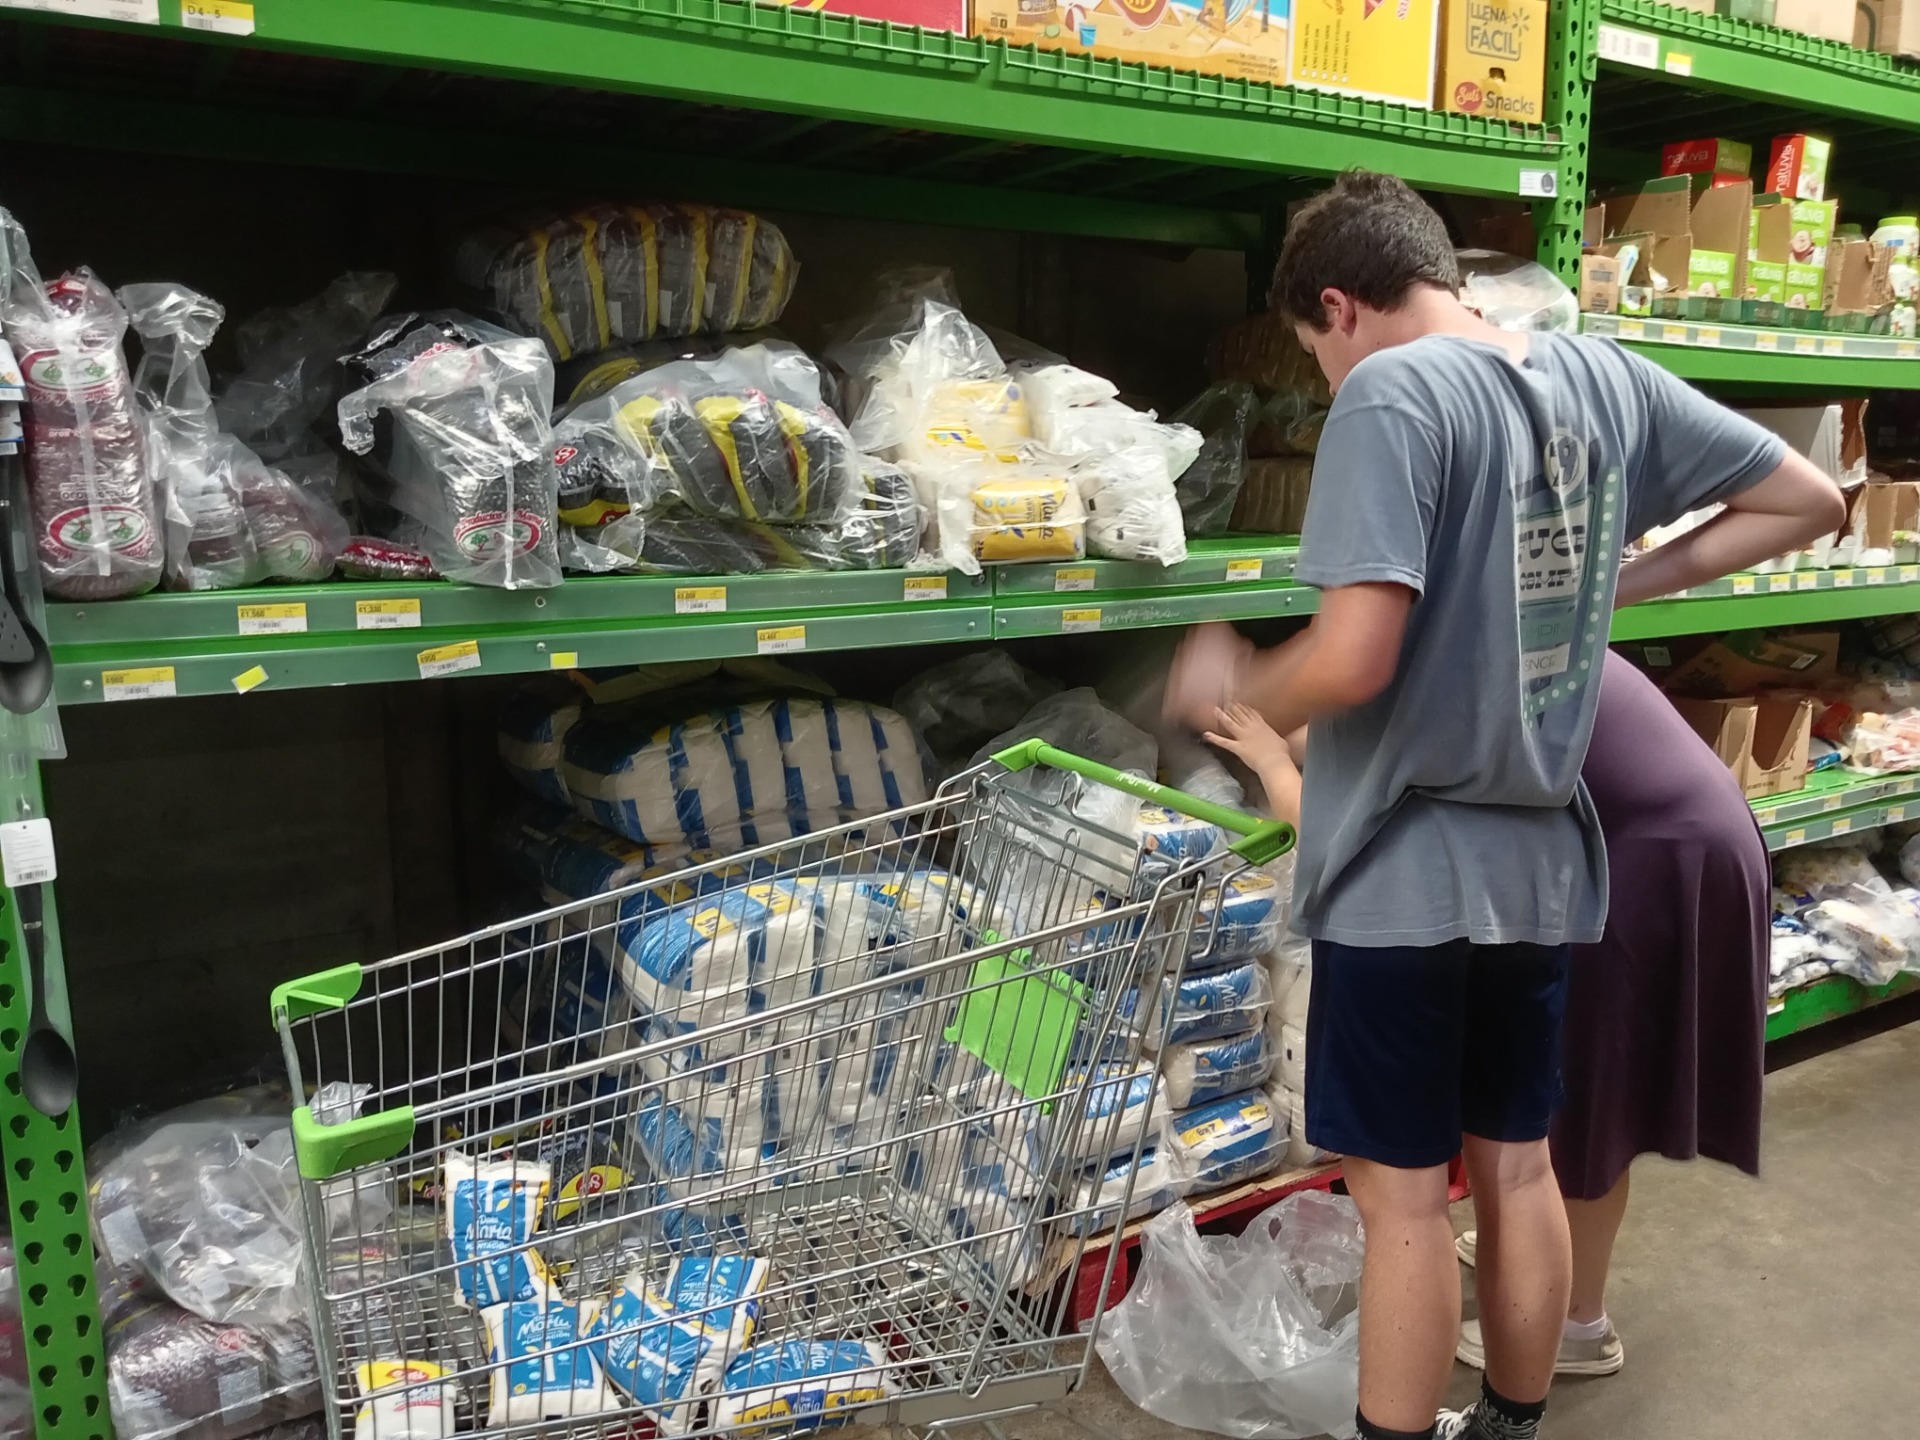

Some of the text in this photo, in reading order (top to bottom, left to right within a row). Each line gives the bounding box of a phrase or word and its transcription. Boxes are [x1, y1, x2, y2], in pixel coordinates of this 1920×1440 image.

[1470, 21, 1517, 55] FÁCIL
[1485, 91, 1535, 115] Snacks
[1667, 149, 1709, 165] natuvia
[1775, 144, 1793, 194] natuvia
